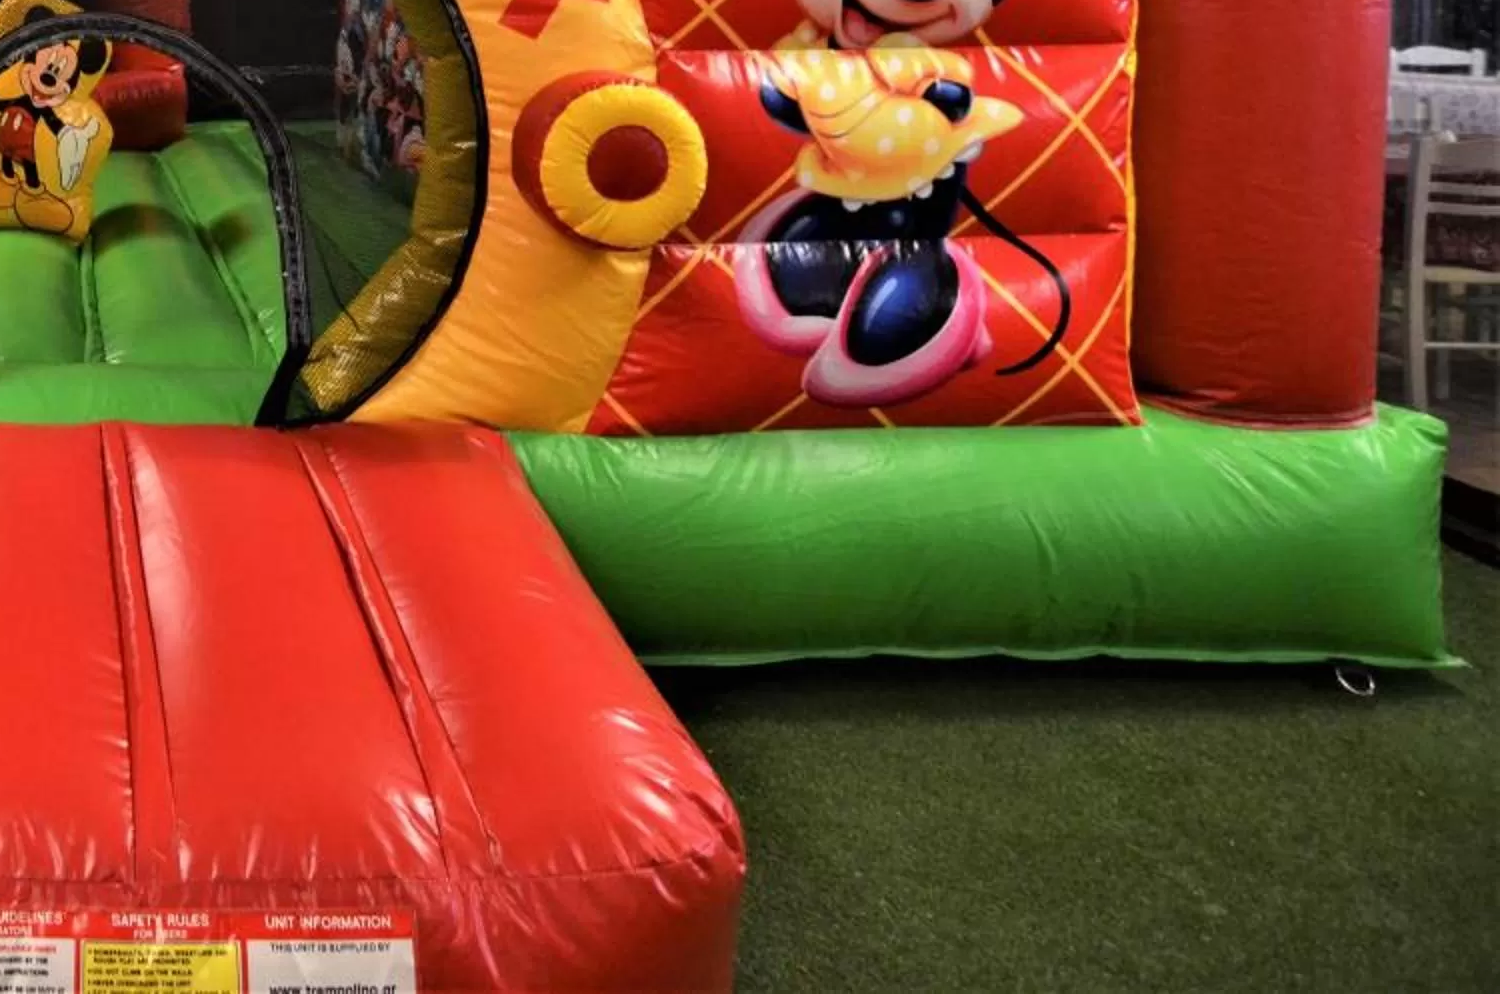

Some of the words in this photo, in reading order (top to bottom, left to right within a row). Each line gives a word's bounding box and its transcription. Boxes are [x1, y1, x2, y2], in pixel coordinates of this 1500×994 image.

[112, 913, 164, 927] SAFETY
[167, 913, 209, 927] RULES
[264, 914, 295, 929] UNIT
[299, 914, 393, 930] INFORMATION
[133, 928, 154, 939] FOR
[269, 984, 396, 994] wwwtrampolinogr
